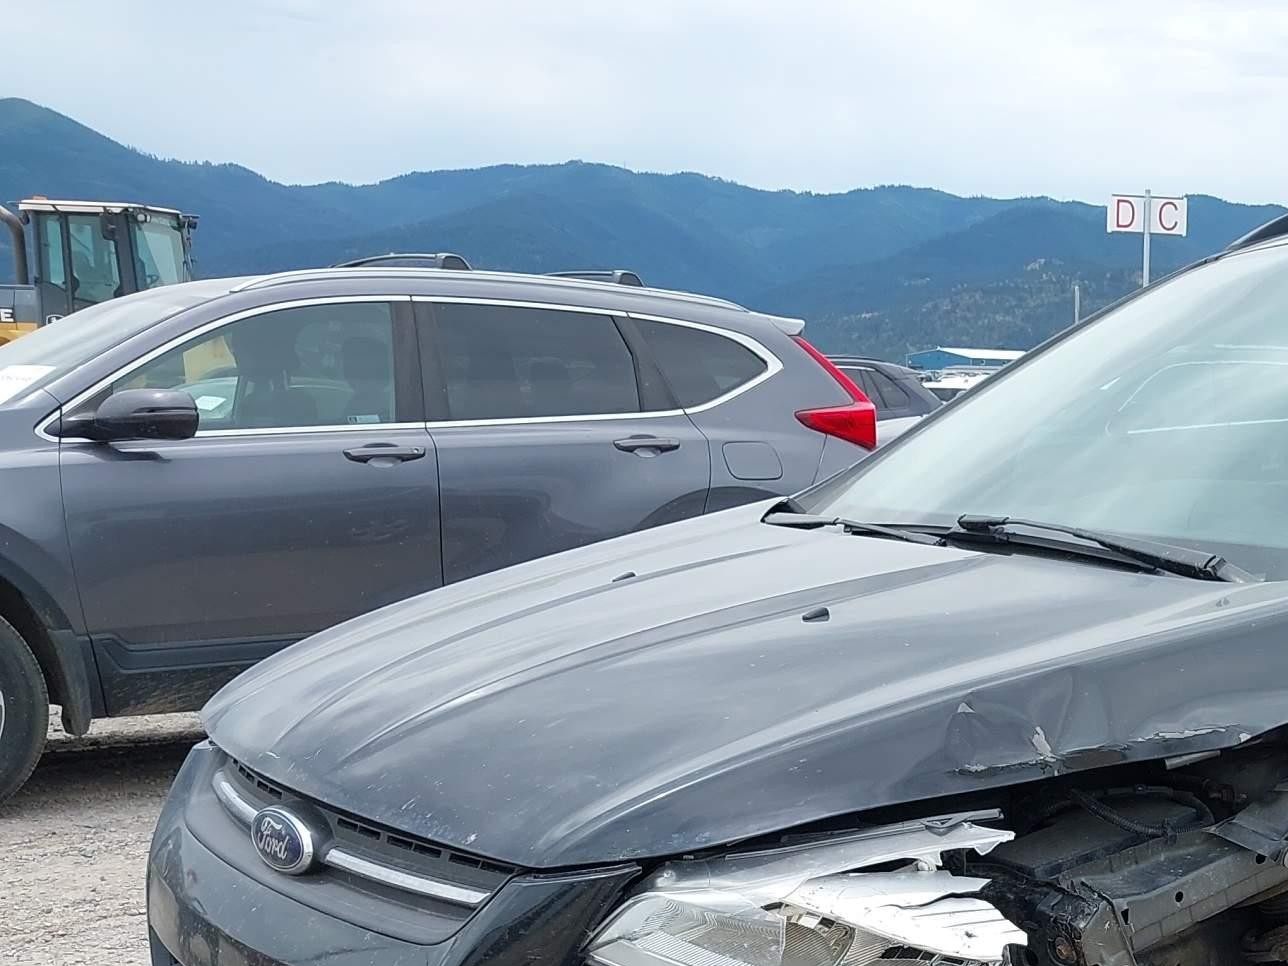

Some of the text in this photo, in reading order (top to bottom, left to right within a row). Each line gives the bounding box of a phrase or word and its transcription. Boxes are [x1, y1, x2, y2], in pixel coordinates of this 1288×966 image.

[1116, 199, 1178, 231] D C
[257, 817, 290, 860] Ford
